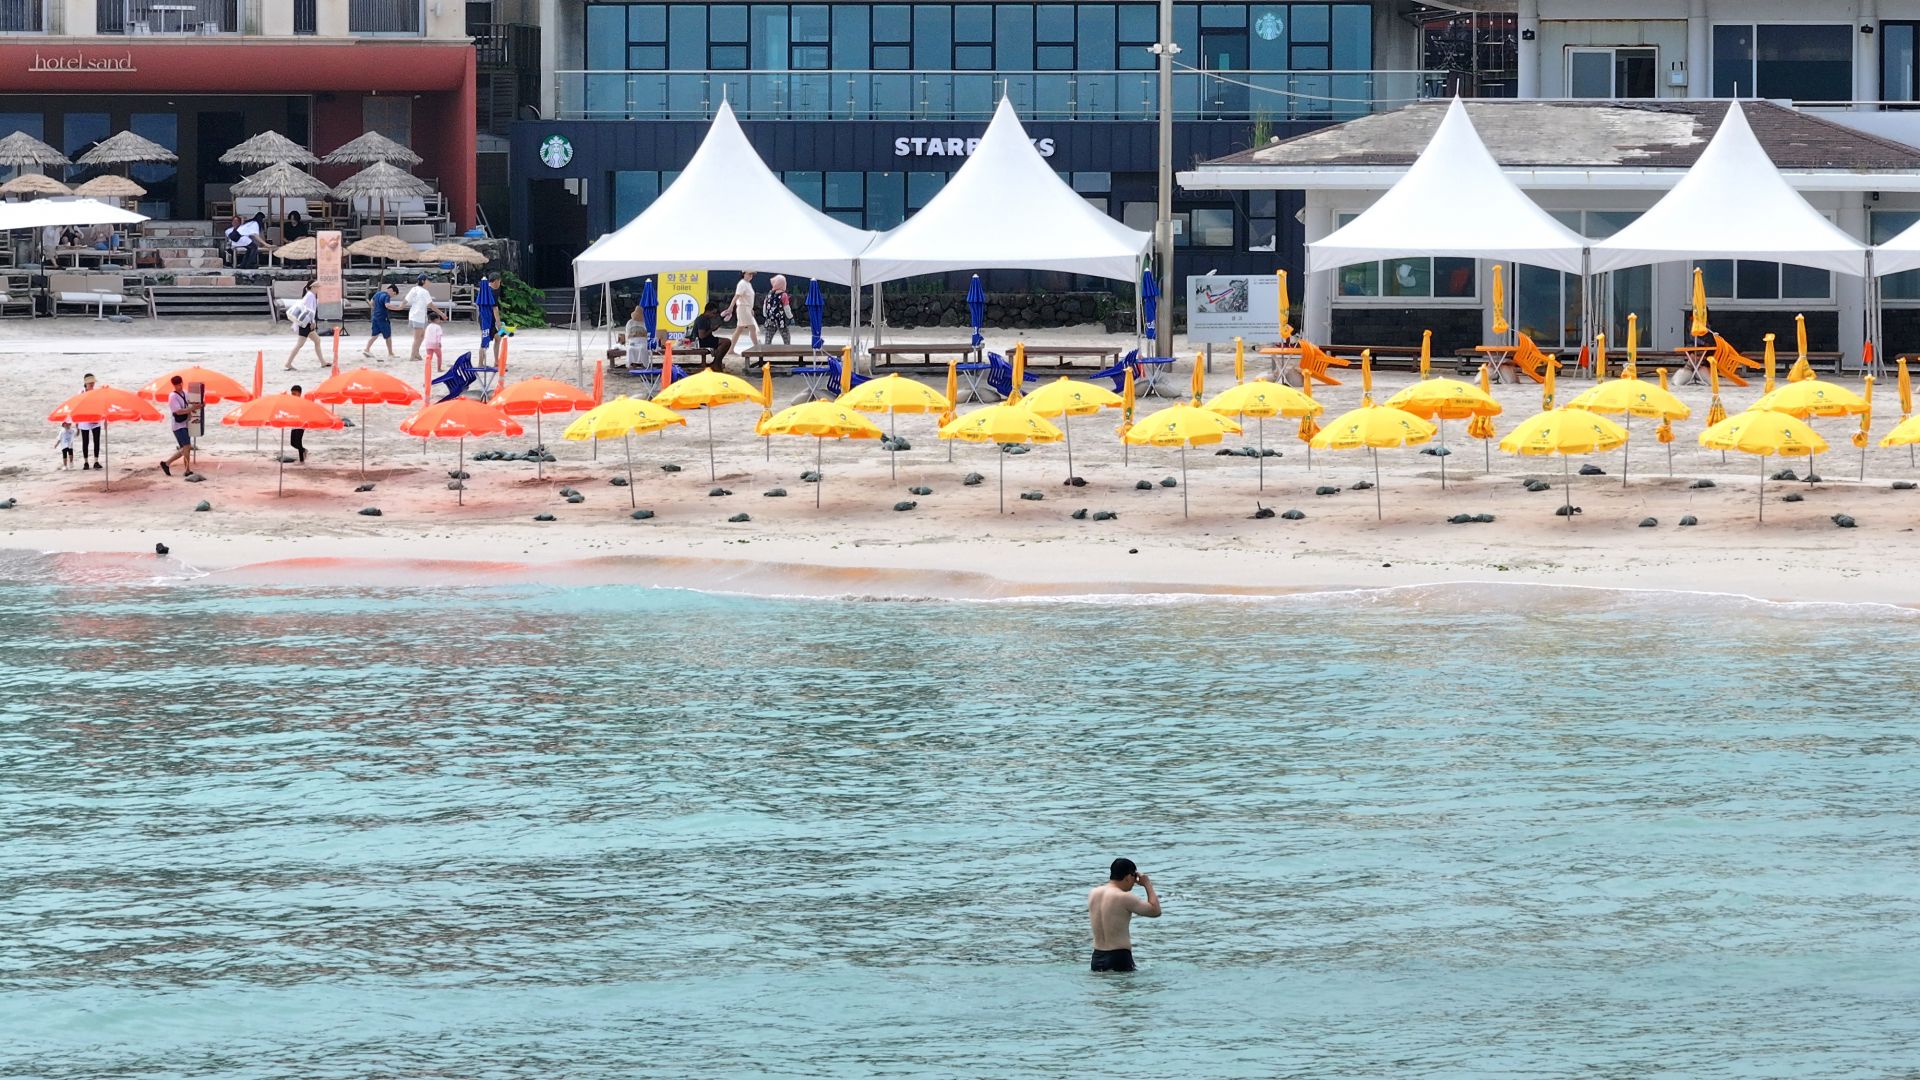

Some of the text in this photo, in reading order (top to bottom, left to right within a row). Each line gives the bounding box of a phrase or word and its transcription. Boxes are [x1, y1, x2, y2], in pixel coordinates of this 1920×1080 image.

[35, 50, 131, 69] hotel sand
[895, 137, 1055, 157] STARBS
